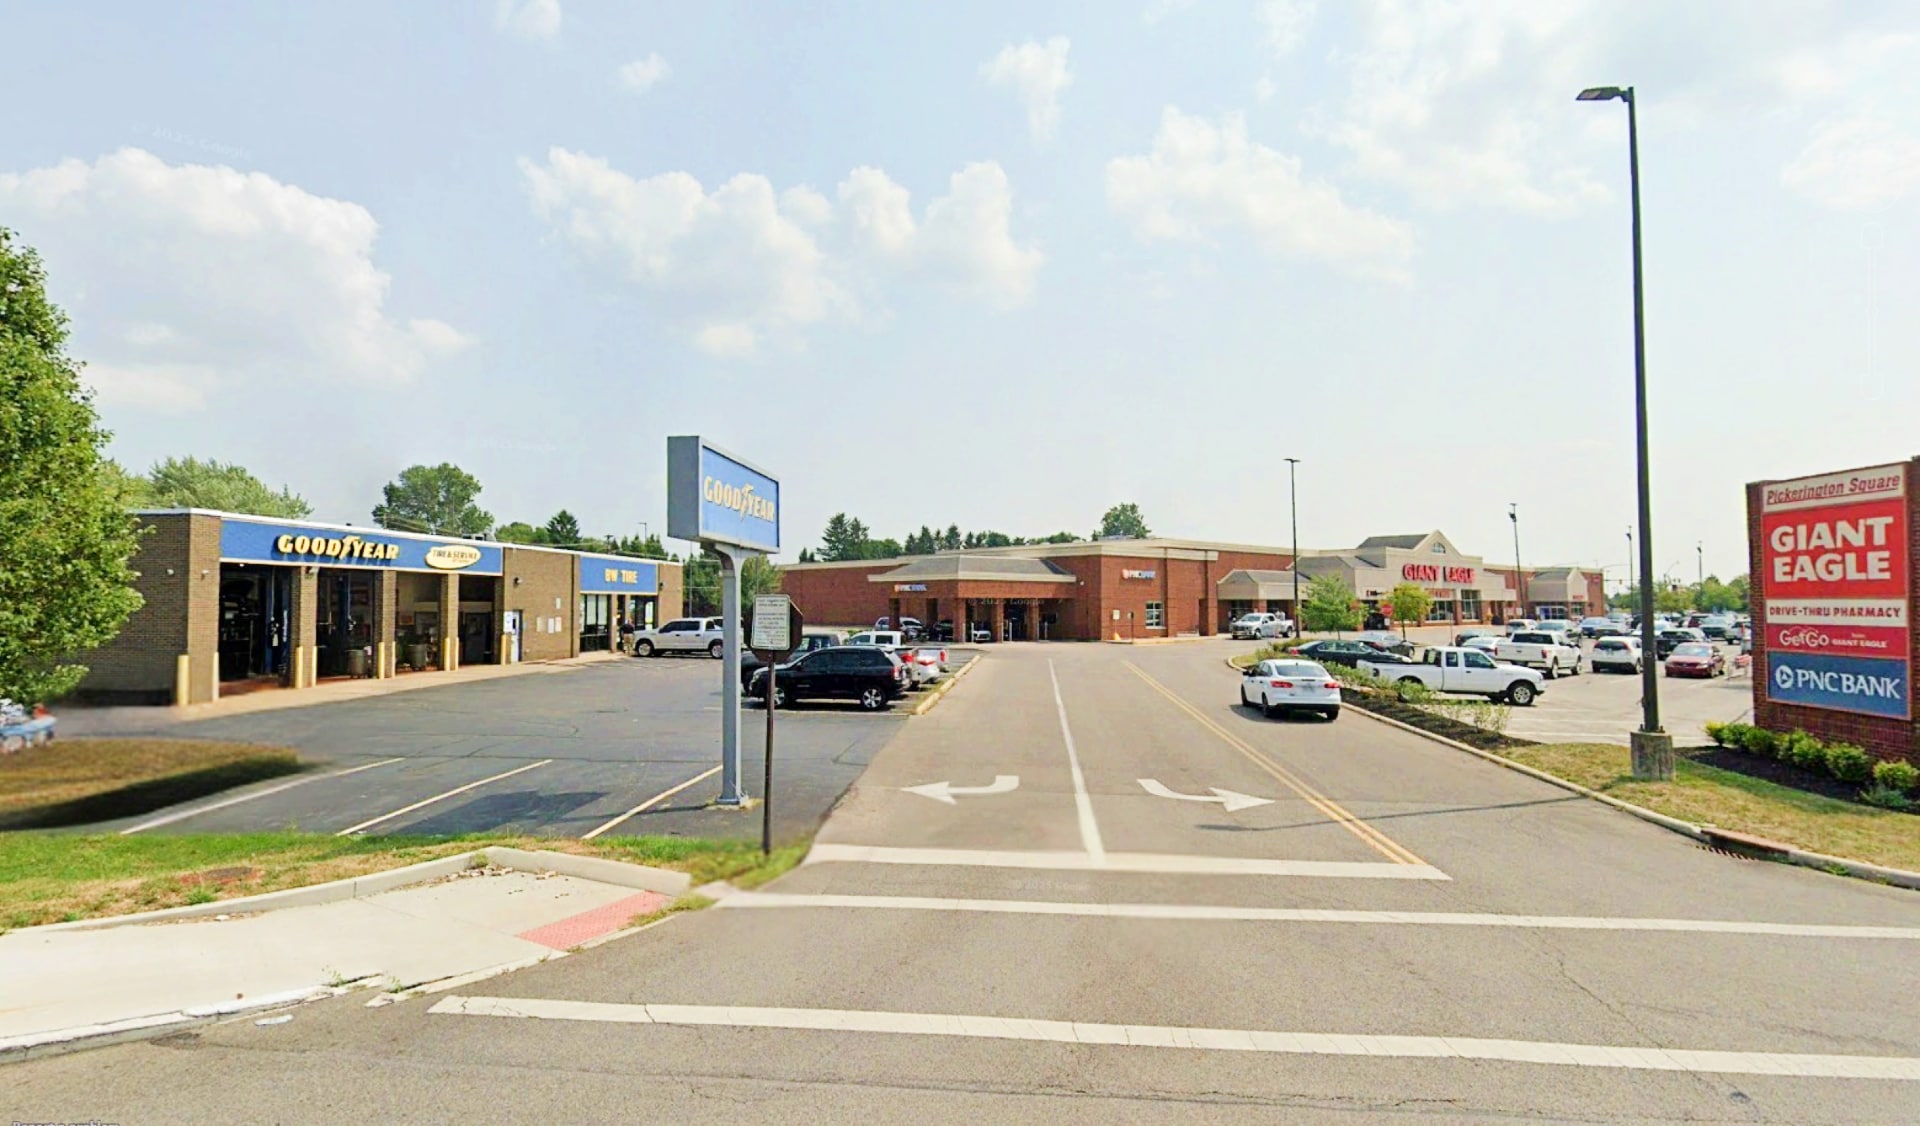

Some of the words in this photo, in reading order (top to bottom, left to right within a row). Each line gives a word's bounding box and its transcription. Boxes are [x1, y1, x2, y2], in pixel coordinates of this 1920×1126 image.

[703, 475, 775, 522] GOODYEAR
[1767, 482, 1845, 505] Pickerington
[1849, 475, 1900, 494] Square
[278, 534, 399, 560] GOODYEAR
[1771, 516, 1893, 552] GIANT
[1403, 564, 1440, 581] GIANT
[1443, 566, 1476, 584] EAGLE
[1773, 551, 1892, 583] EAGLE
[1769, 606, 1831, 616] DRIVE-THRU
[1833, 607, 1901, 618] PHARMACY
[1779, 629, 1829, 647] GetGo
